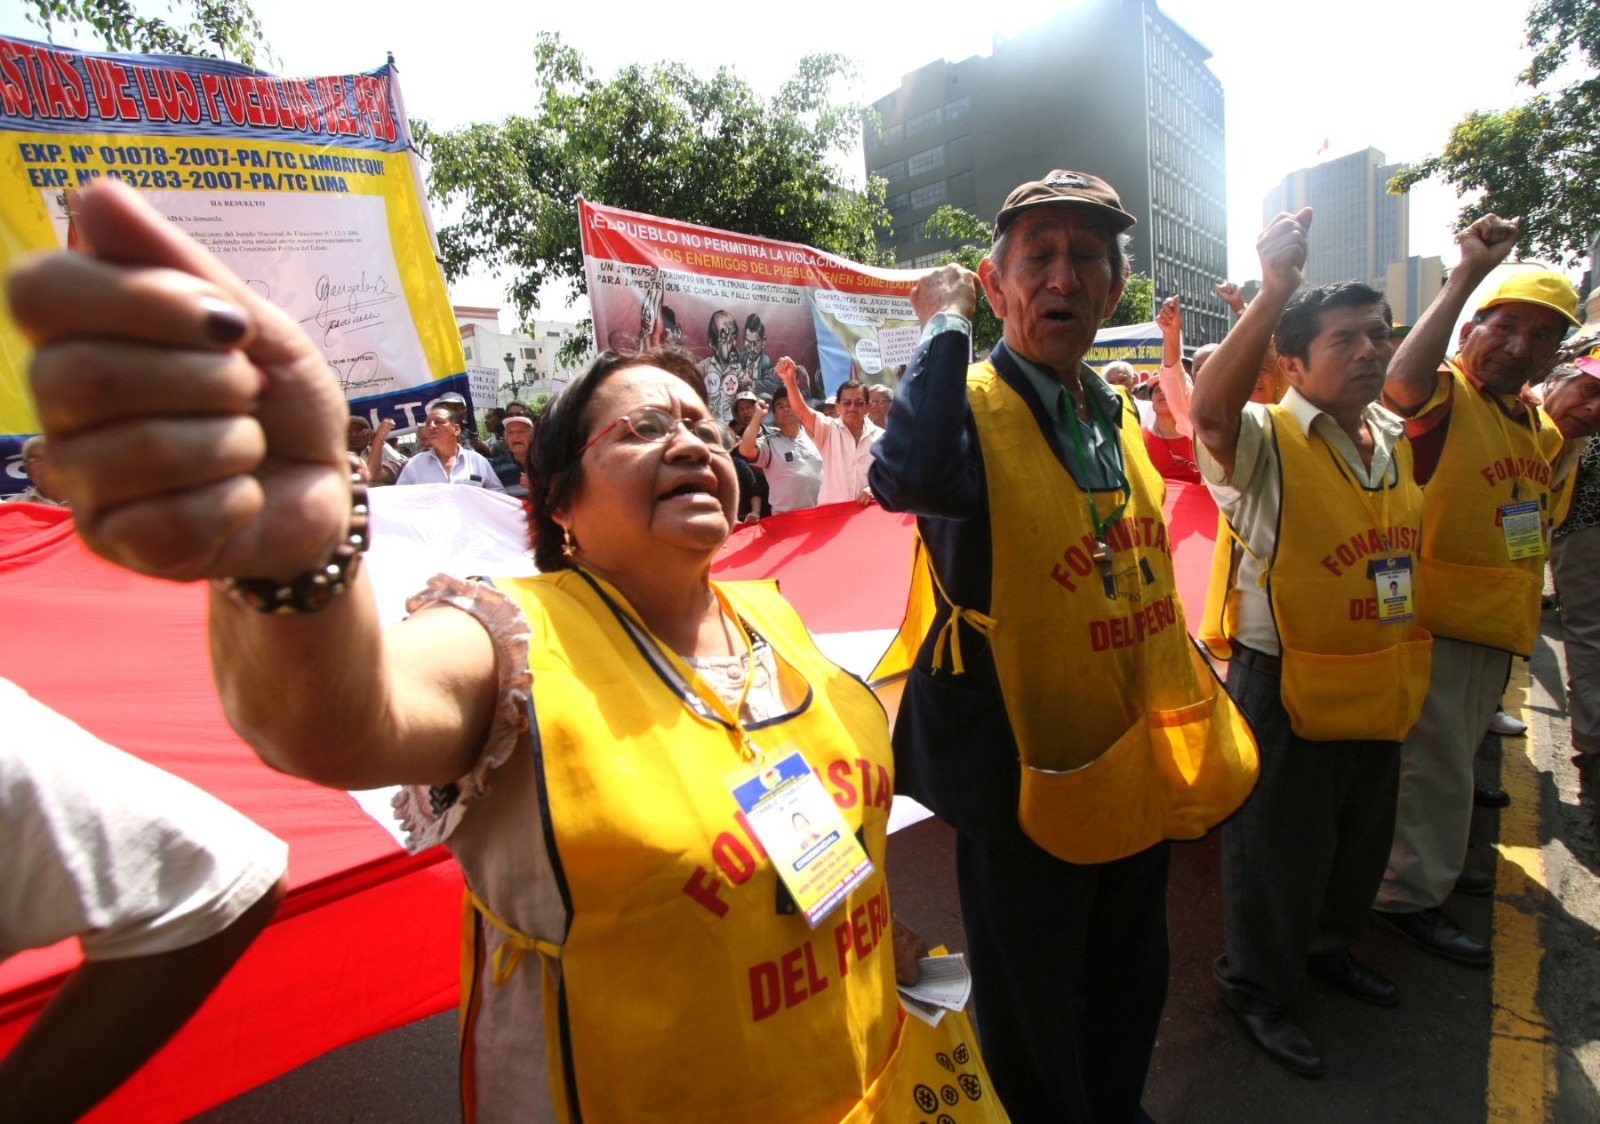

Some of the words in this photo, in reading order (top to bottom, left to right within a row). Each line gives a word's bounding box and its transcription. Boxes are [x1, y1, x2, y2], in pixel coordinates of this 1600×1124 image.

[82, 55, 140, 119] DE
[315, 75, 360, 135] DEL
[18, 143, 66, 163] EXP.
[99, 145, 302, 169] 01078-2007-PA/TC
[299, 153, 385, 176] LAMBAYEQUE
[27, 168, 73, 188] EXP.
[312, 174, 349, 193] LIMA
[617, 220, 678, 244] PUEBLO
[681, 233, 701, 247] NO
[704, 238, 768, 259] PERMITIRÁ
[770, 248, 785, 261] LA
[600, 262, 614, 272] UN
[718, 279, 750, 290] TRIBUNAL
[751, 284, 799, 295] CONSTITUCIONAL
[655, 248, 683, 264] LOS
[685, 253, 748, 272] ENEMIGOS
[751, 264, 771, 276] DEL
[774, 265, 814, 280] PUEBLO
[816, 270, 853, 284] TIENEN
[597, 274, 620, 285] PARA
[665, 281, 681, 292] QUE
[683, 285, 692, 293] SE
[721, 290, 730, 299] EL
[731, 291, 750, 300] FALLO
[1089, 616, 1134, 652] DEL
[1134, 595, 1177, 642] PERU
[1350, 597, 1378, 621] DE
[748, 940, 829, 1022] DEL
